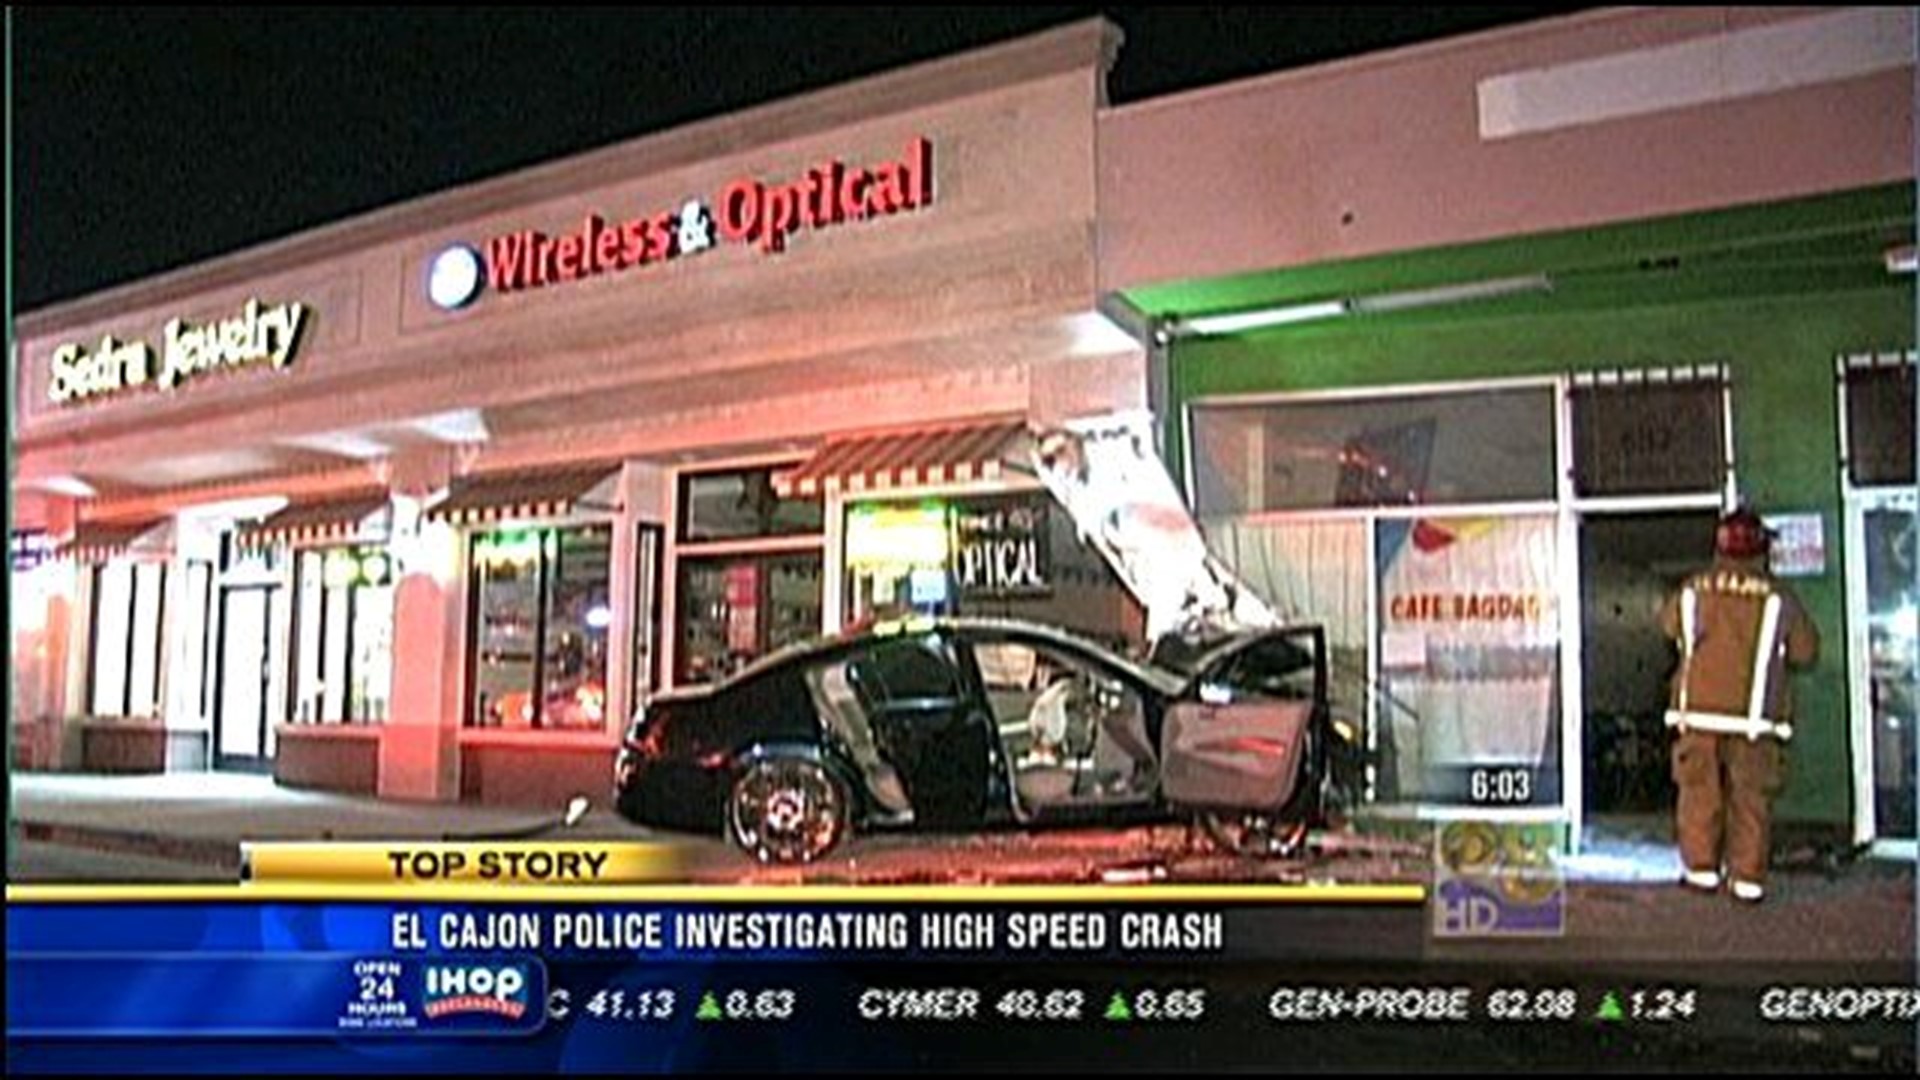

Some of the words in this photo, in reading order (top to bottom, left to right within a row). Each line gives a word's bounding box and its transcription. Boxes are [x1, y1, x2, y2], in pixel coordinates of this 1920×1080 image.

[484, 212, 676, 293] Wireless
[676, 200, 712, 256] &
[716, 138, 934, 253] Optical
[158, 298, 308, 391] Jewelry
[1391, 594, 1442, 622] CAFE
